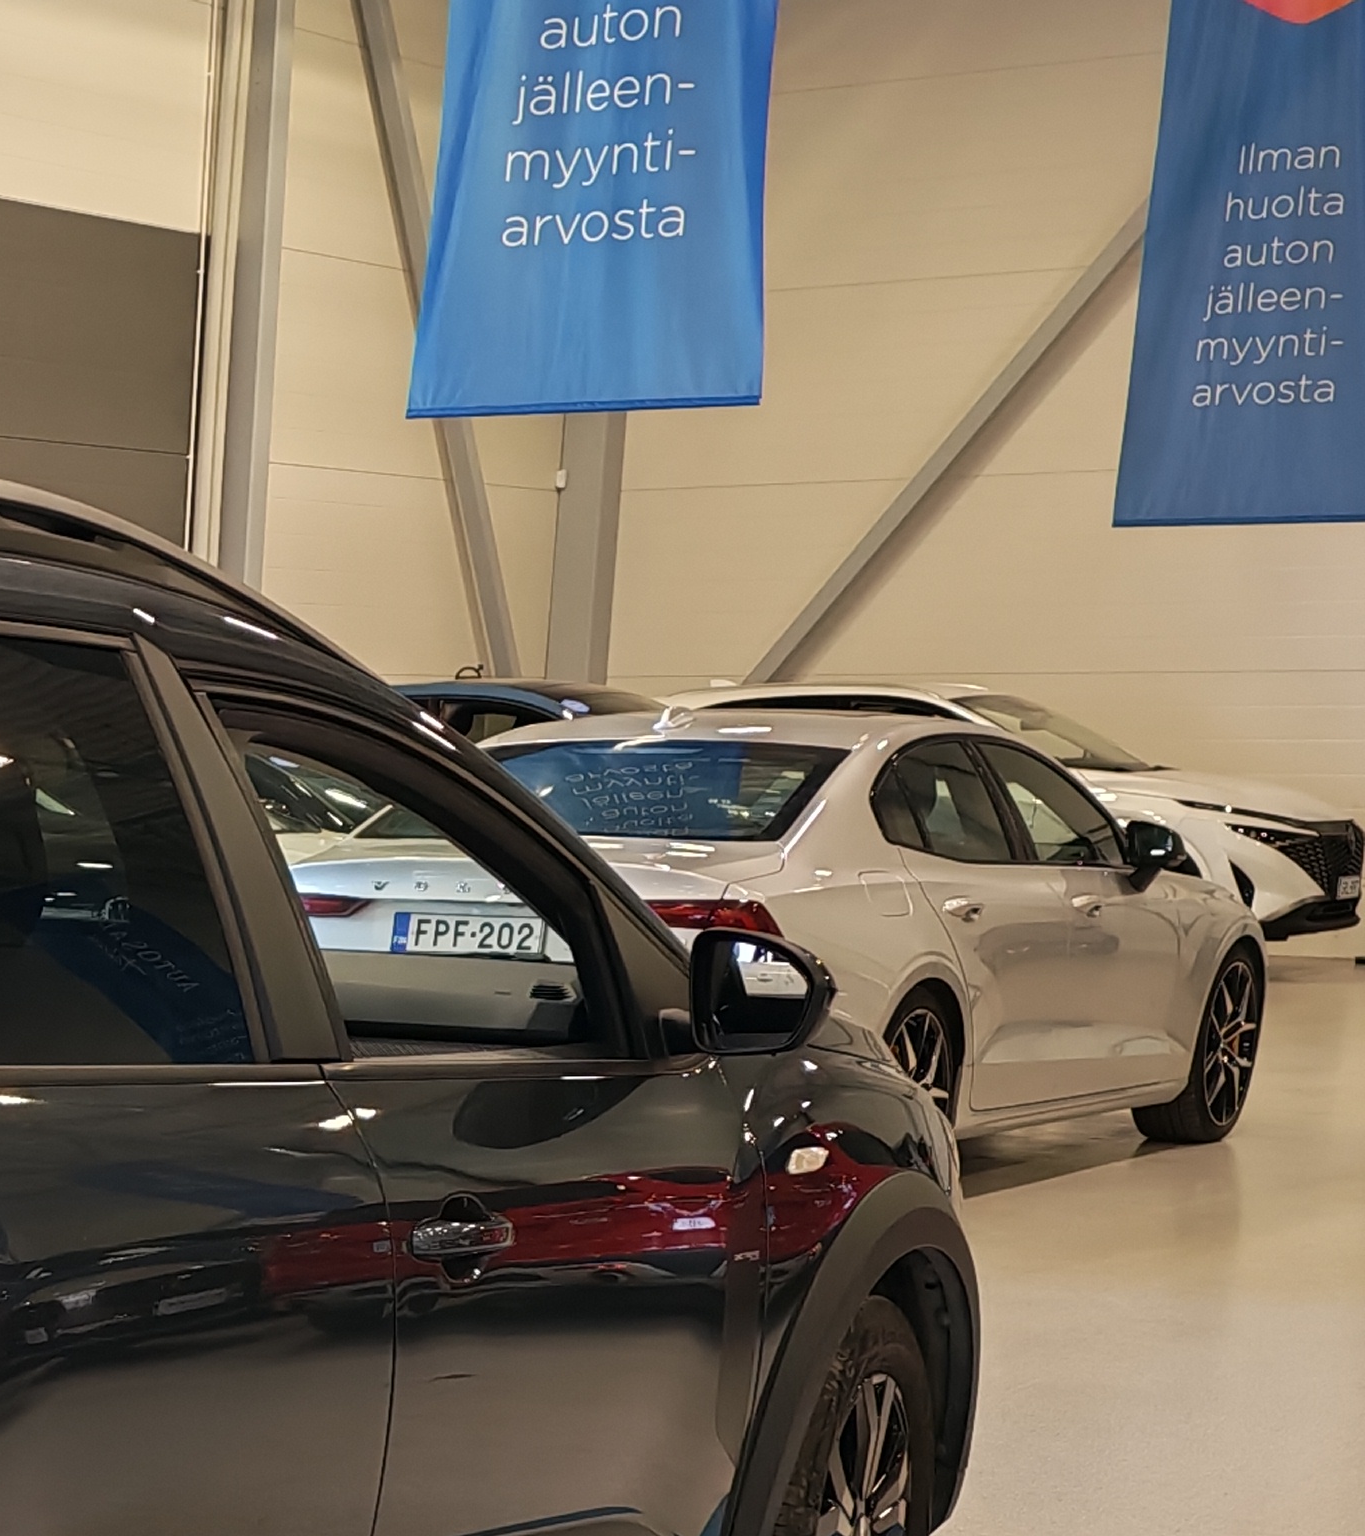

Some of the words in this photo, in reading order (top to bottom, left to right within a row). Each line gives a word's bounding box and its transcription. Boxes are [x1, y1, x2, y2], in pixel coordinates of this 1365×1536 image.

[539, 3, 682, 50] auton
[511, 69, 696, 125] jälleen-
[504, 128, 697, 189] myynti-
[1238, 142, 1342, 175] Ilman
[501, 198, 685, 248] arvosta
[1225, 185, 1345, 222] huolta
[1223, 236, 1335, 268] auton
[1202, 281, 1344, 322] jälleen-
[1195, 325, 1345, 366] myynti-
[1191, 373, 1336, 407] arvosta
[414, 918, 535, 951] FPF-202
